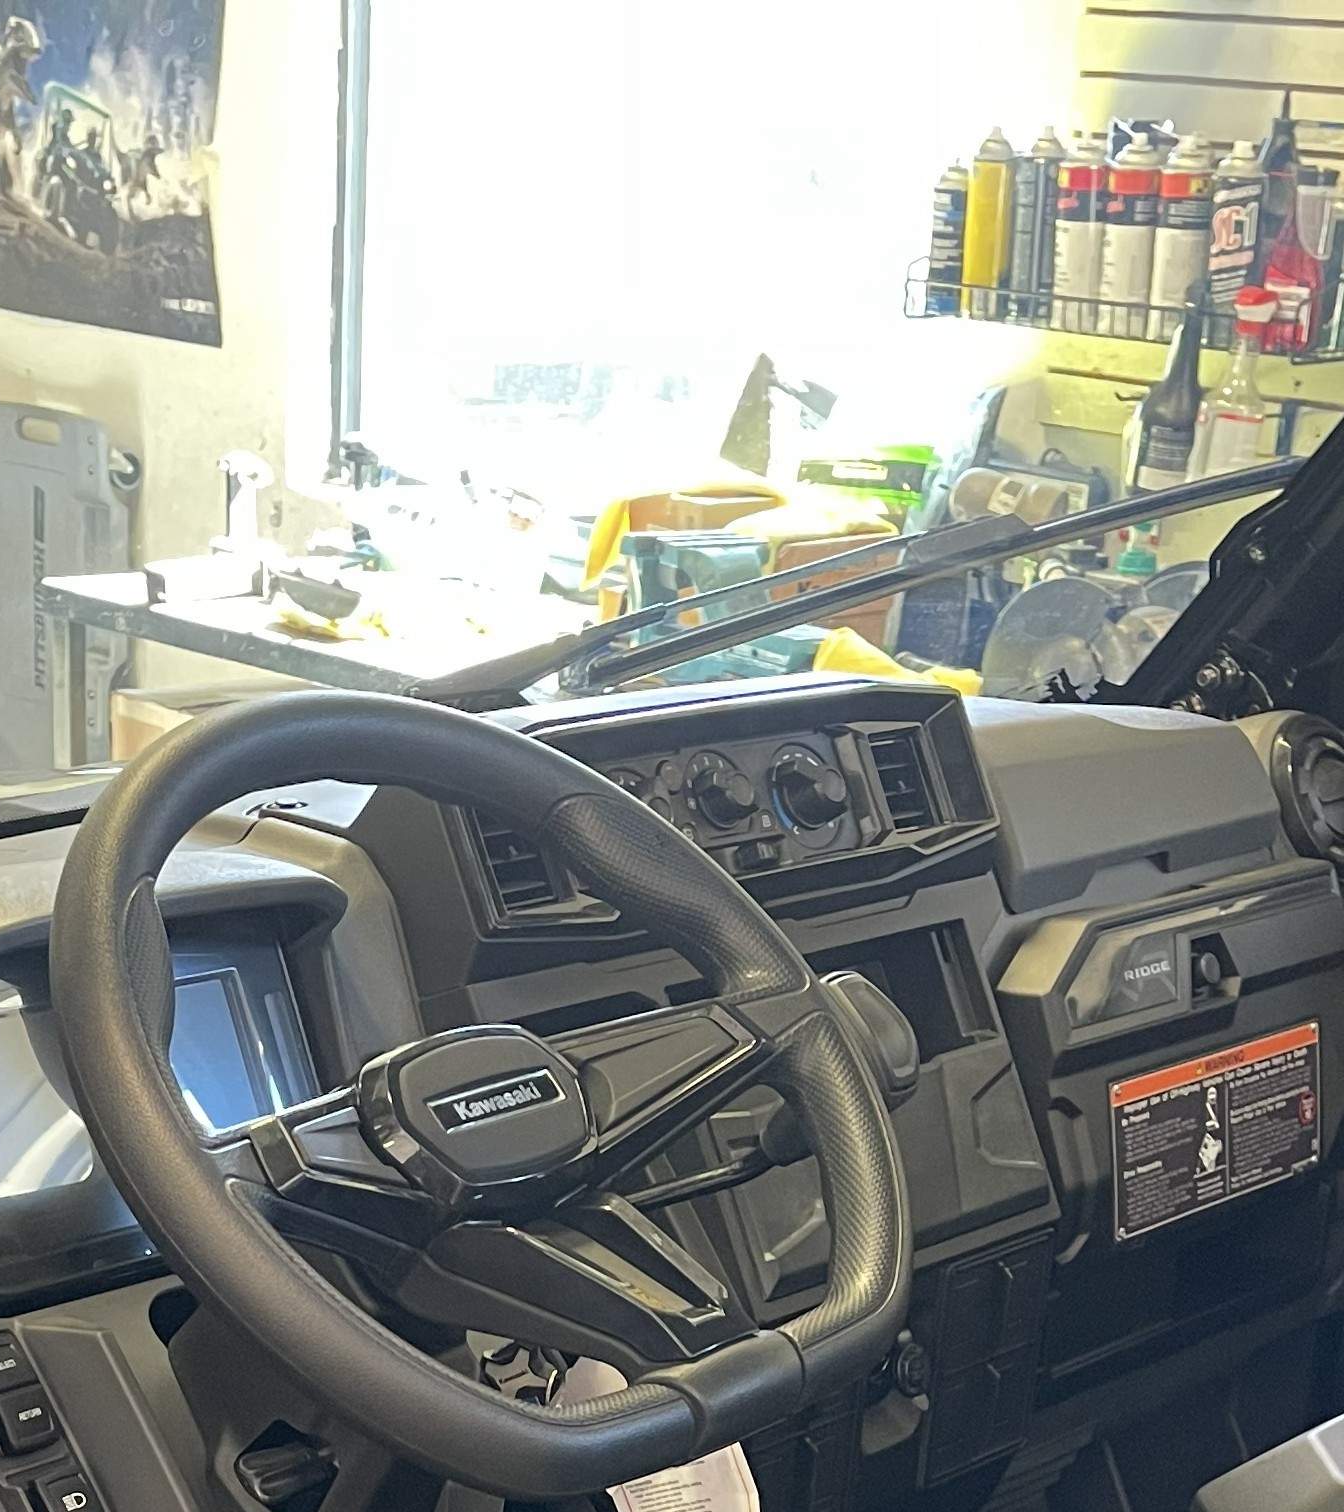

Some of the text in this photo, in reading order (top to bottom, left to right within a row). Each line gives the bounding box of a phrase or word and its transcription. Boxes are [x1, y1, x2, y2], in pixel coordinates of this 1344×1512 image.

[1123, 961, 1171, 982] RIDGE
[1205, 1050, 1244, 1071] WARNING
[452, 1081, 542, 1121] Kawasaki
